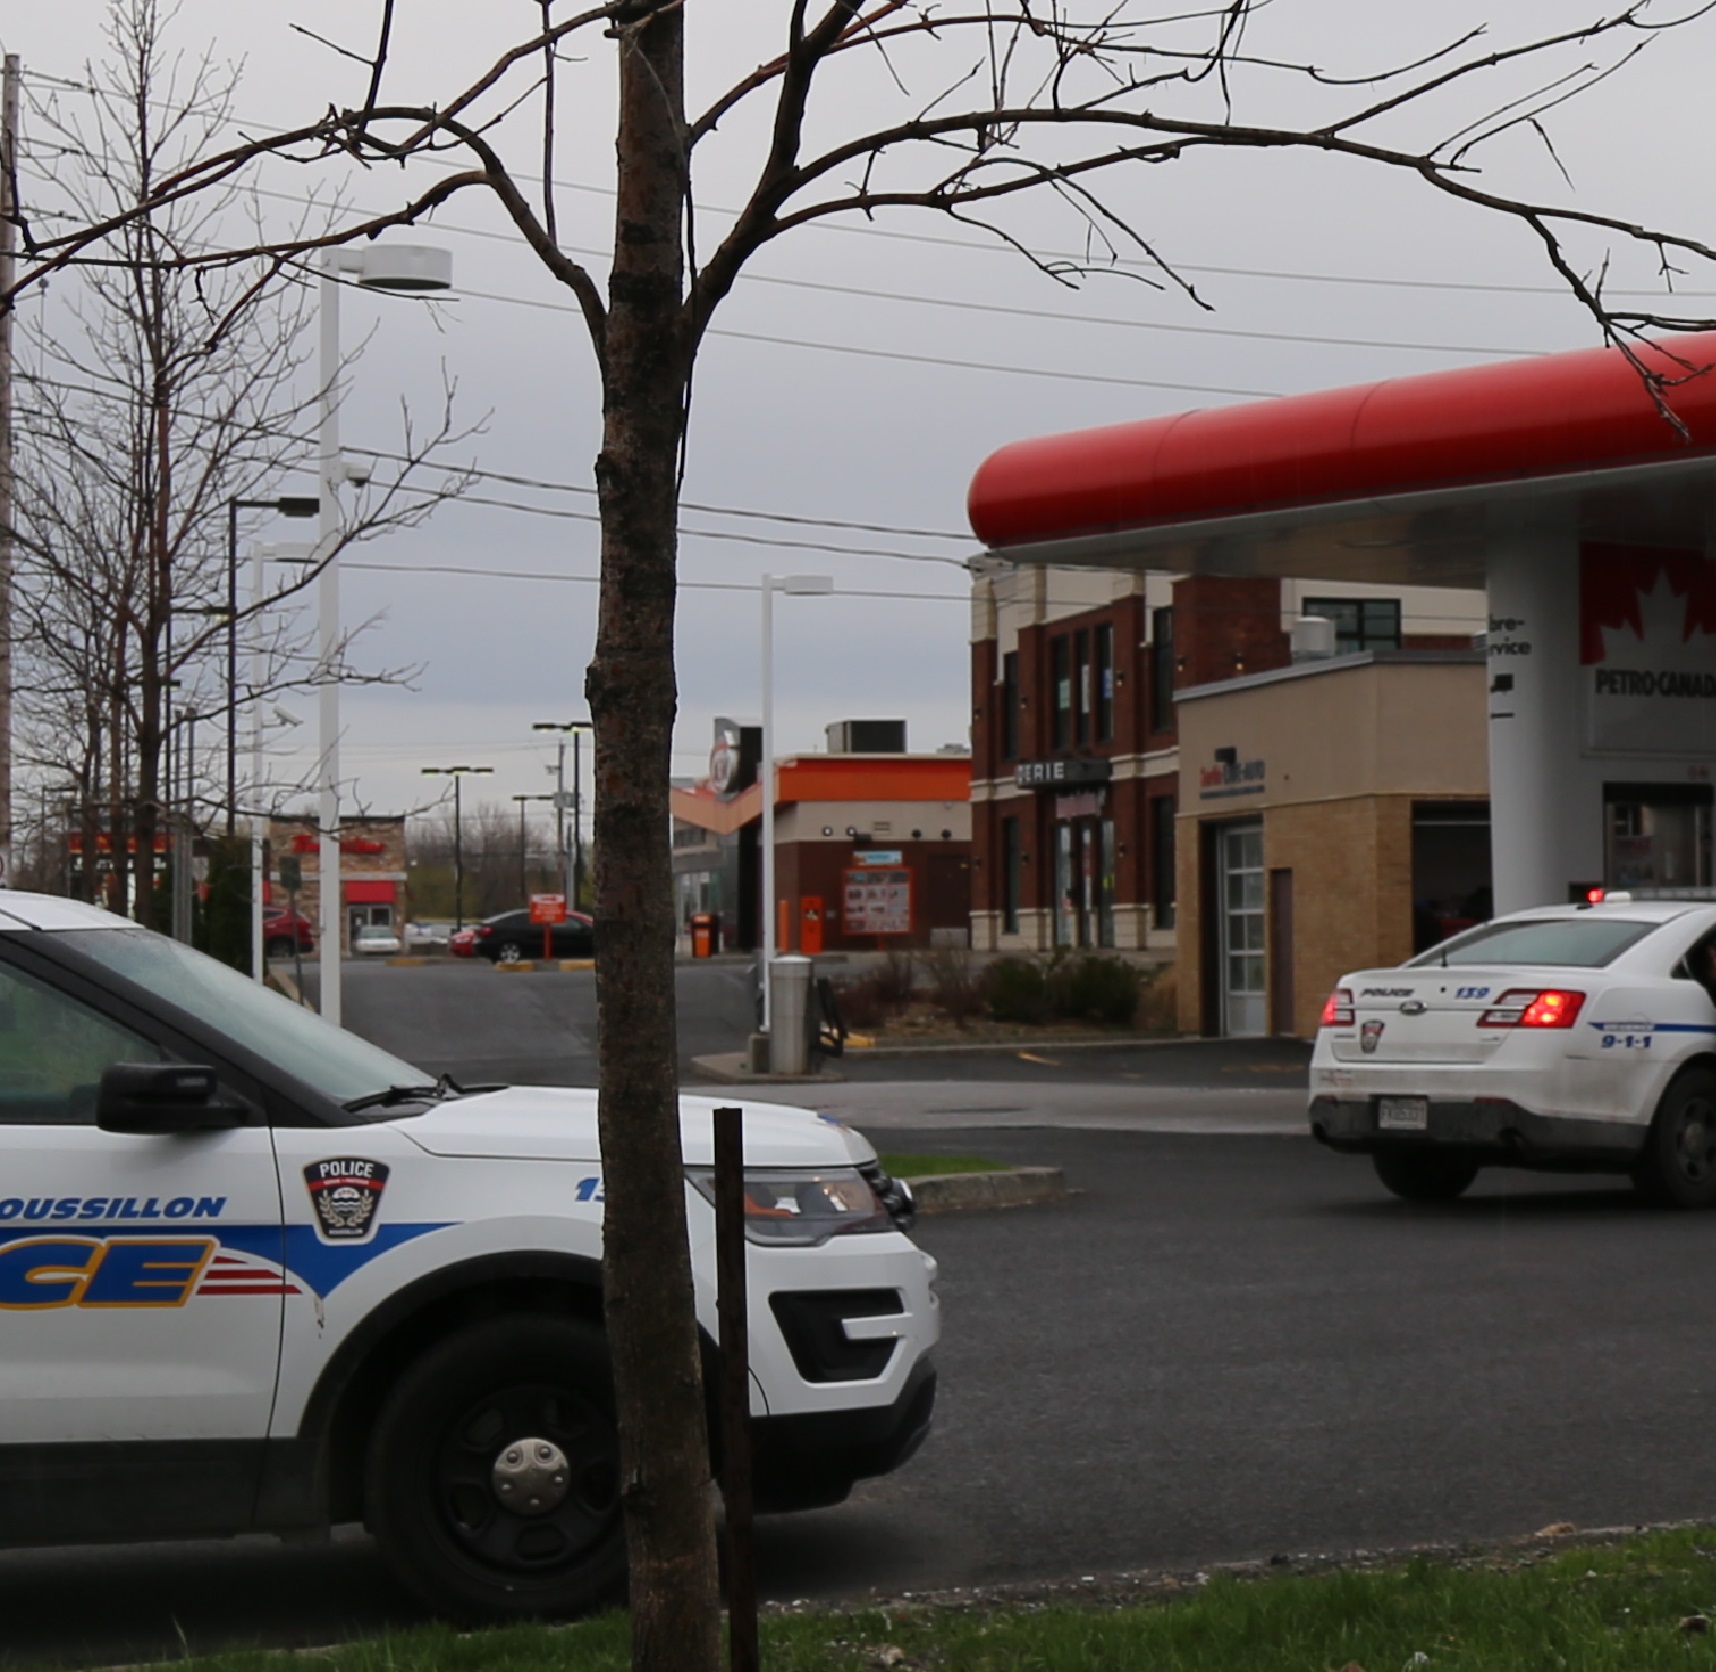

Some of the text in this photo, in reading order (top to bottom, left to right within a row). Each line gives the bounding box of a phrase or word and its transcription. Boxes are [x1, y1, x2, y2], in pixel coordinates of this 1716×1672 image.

[1601, 1035, 1652, 1048] 9-1-1
[320, 1161, 374, 1178] POLICE
[0, 1197, 227, 1220] OUSSILLON
